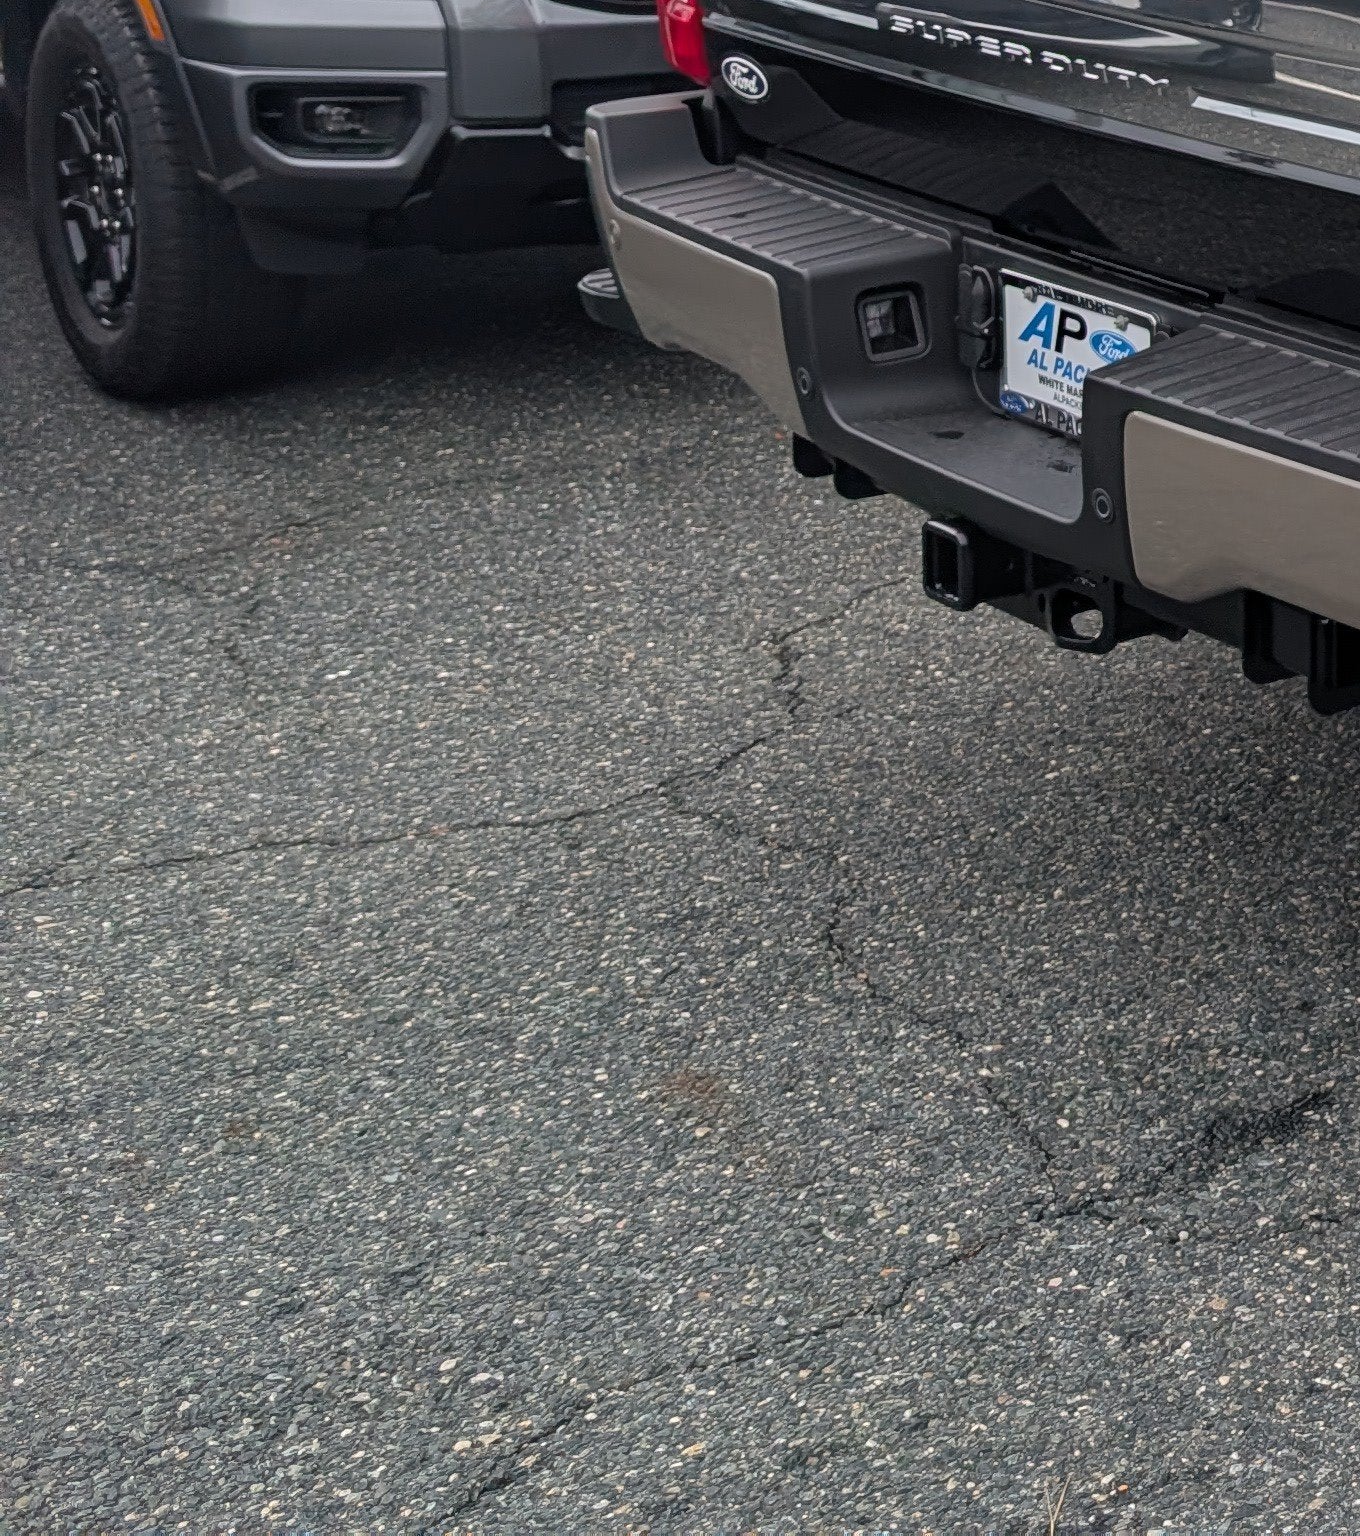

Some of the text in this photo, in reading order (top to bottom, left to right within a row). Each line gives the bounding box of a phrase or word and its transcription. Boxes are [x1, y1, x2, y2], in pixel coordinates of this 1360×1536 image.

[729, 62, 759, 94] Ford
[890, 14, 1170, 100] SUPER DUTY
[1018, 301, 1088, 354] AP
[1026, 349, 1091, 384] AL PAC
